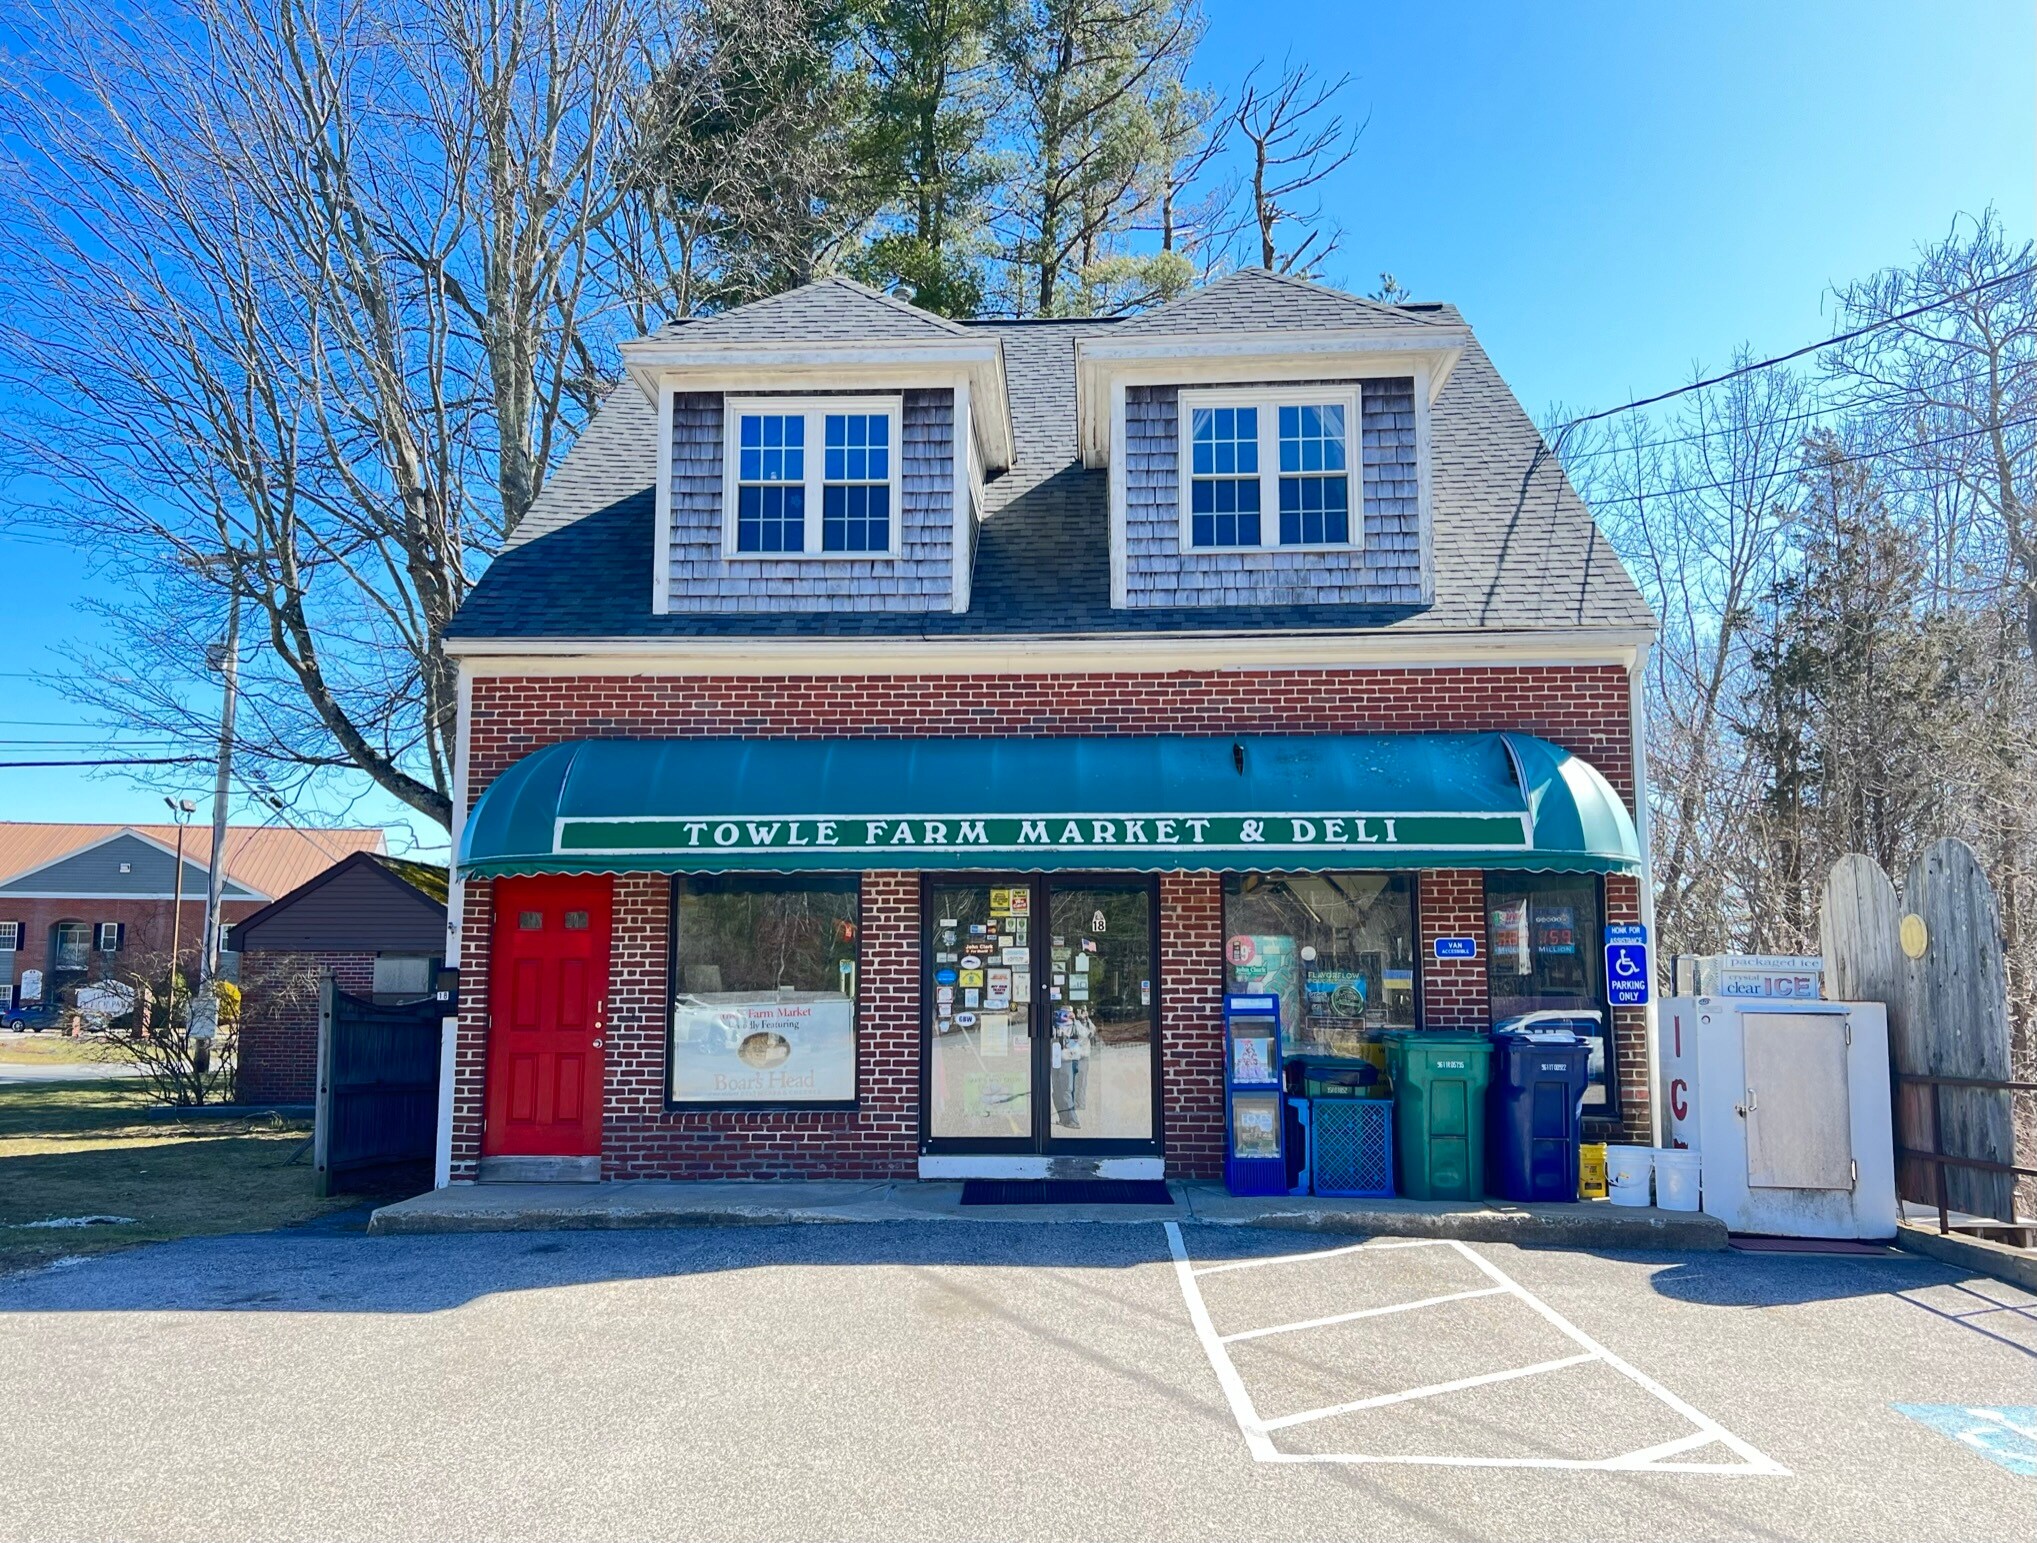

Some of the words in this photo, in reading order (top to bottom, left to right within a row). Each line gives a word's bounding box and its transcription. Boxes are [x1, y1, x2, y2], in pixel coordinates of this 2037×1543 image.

[683, 821, 840, 846] TOWLE
[865, 820, 989, 845] FARM
[1016, 819, 1211, 844] MARKET
[1239, 818, 1265, 842] &
[1291, 818, 1398, 843] DELI
[1092, 920, 1105, 931] 18
[1611, 926, 1627, 935] HONK
[1628, 926, 1640, 934] FOR
[1610, 936, 1643, 944] ASSISTANCE
[1538, 946, 1572, 954] MILLION
[1730, 957, 1796, 968] packaged
[1800, 958, 1820, 968] ice
[1729, 973, 1761, 982] crystal
[1611, 980, 1645, 990] PARKING
[1727, 982, 1762, 995] clear
[1764, 976, 1812, 997] ICE
[1619, 991, 1639, 1002] ONLY
[748, 1008, 774, 1018] Farm
[777, 1006, 812, 1018] Market
[761, 1019, 800, 1030] Featuring
[768, 1069, 815, 1089] Head
